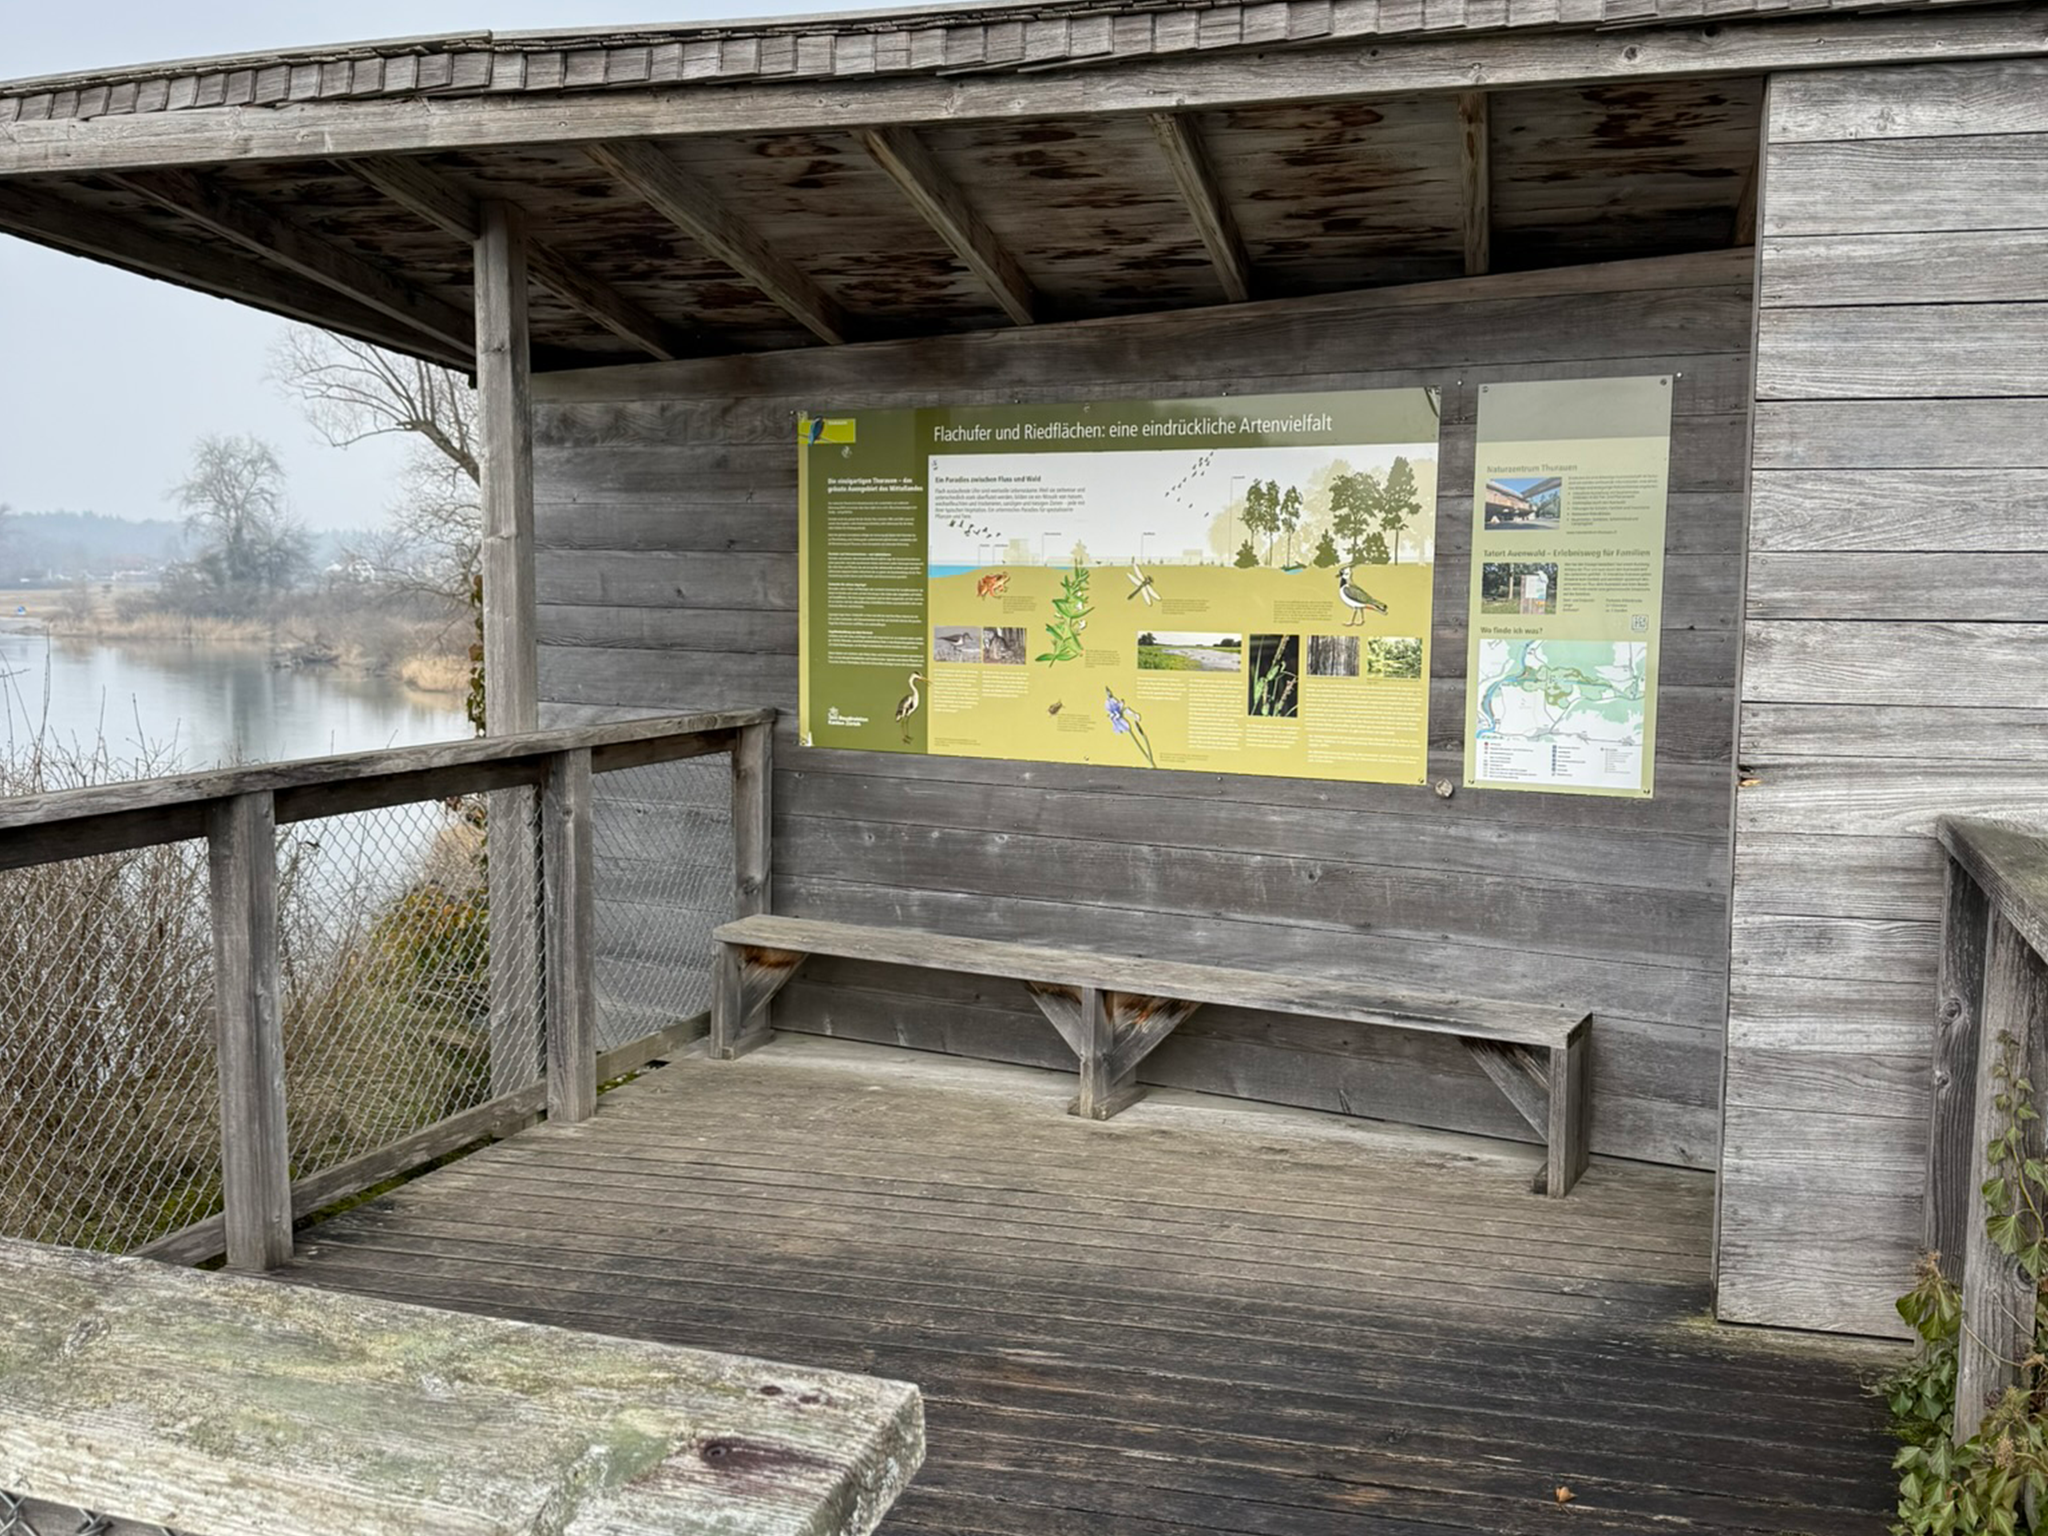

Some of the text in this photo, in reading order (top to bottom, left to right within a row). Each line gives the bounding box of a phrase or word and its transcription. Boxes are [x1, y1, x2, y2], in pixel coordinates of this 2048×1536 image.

[934, 414, 1333, 442] Flachufer und Riedflächen: eine eindrückliche Artenvielfalt
[1553, 549, 1601, 558] Erlebnisweg
